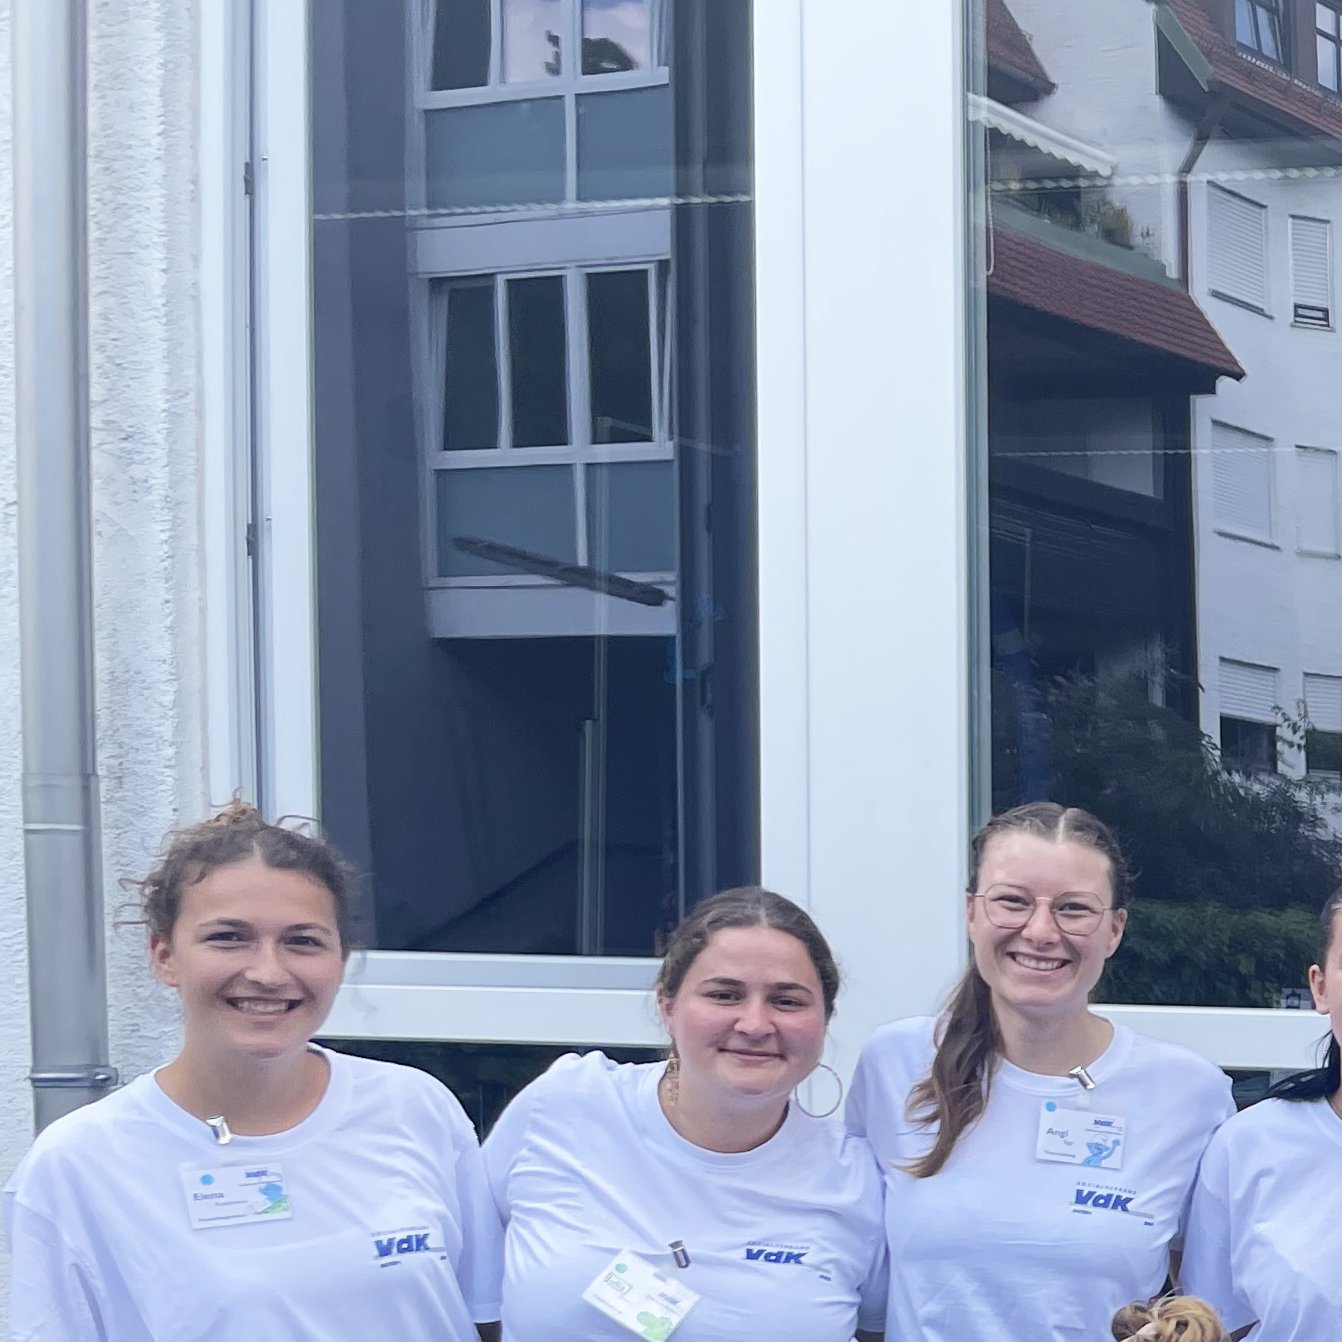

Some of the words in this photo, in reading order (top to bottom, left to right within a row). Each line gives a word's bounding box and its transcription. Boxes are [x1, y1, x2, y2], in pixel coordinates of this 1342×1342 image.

[1074, 1189, 1134, 1213] VdK
[373, 1232, 431, 1257] VdK
[745, 1248, 808, 1265] VdK
